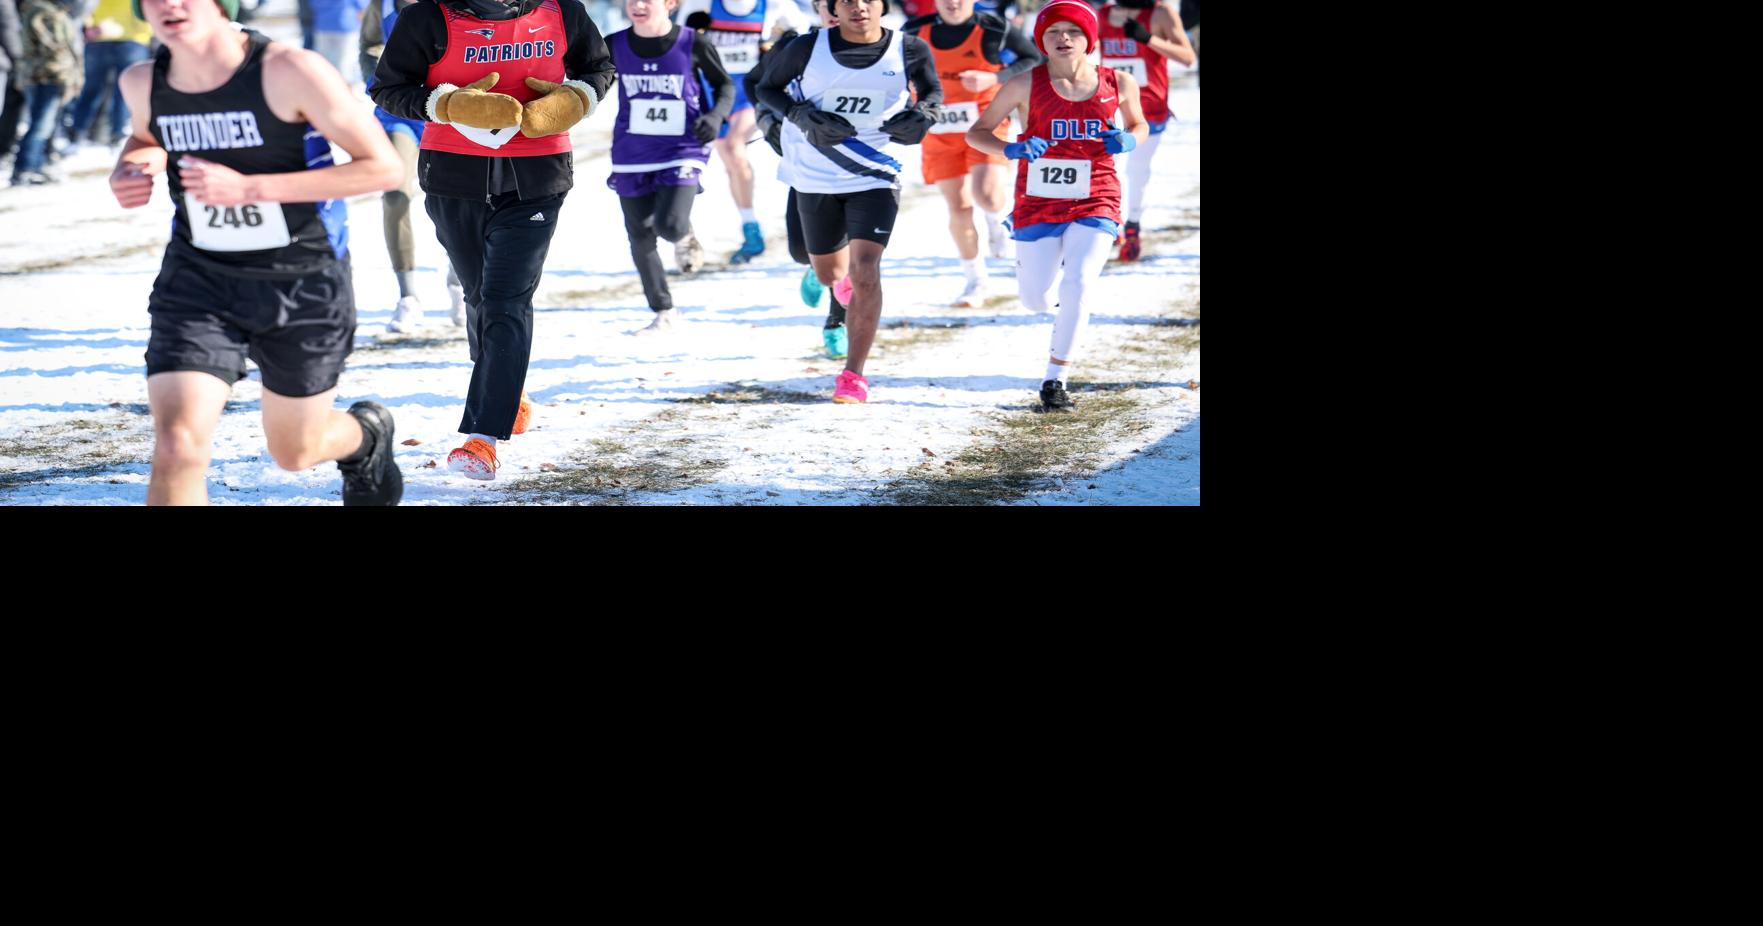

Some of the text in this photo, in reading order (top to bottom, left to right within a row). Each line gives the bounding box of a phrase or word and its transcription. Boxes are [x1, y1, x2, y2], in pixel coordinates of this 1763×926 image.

[464, 40, 555, 63] PATRIOTS
[1103, 38, 1137, 56] DLB
[645, 107, 668, 122] 44
[834, 96, 871, 114] 272
[157, 111, 264, 152] THUNDER
[1051, 119, 1102, 140] DLB
[1040, 167, 1077, 184] 129
[204, 204, 262, 228] 246
